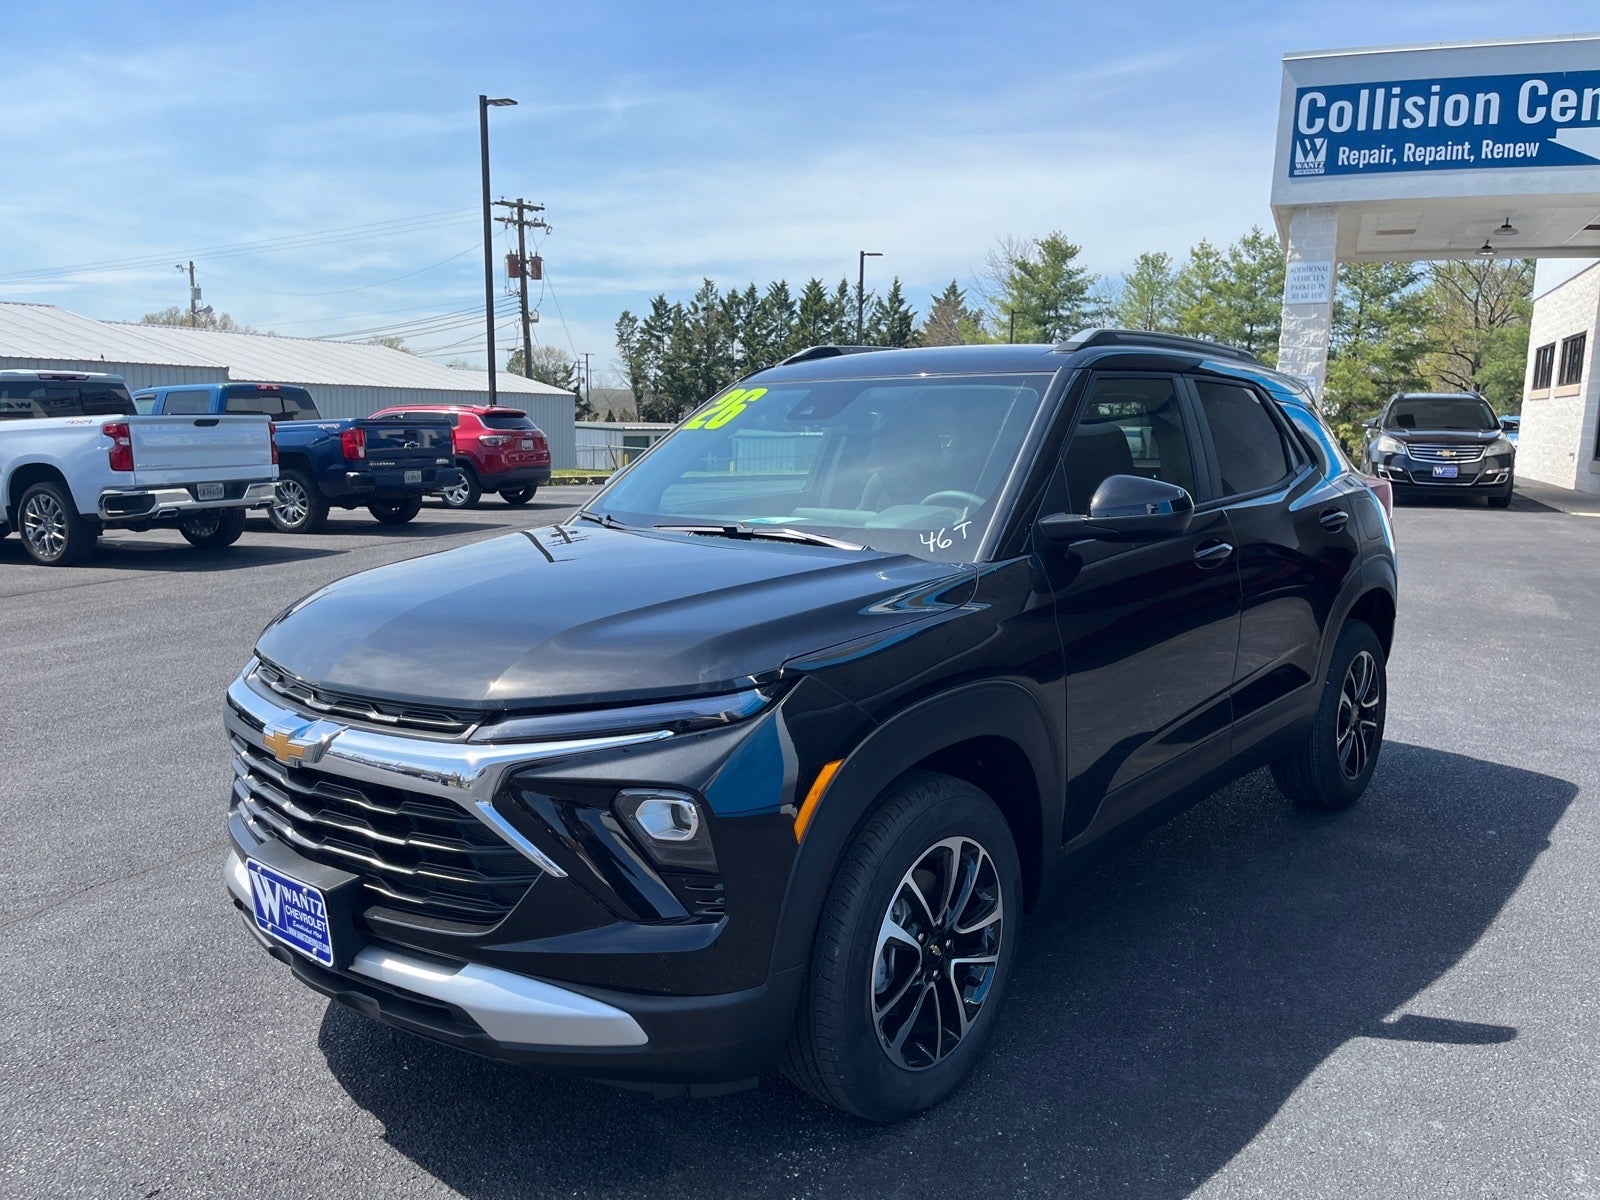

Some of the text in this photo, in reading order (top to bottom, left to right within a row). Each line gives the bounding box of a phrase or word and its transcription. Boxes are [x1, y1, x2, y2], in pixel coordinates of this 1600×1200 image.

[1298, 85, 1500, 135] Collision
[1295, 162, 1325, 170] WANTZ
[1338, 139, 1540, 168] Repair, Repaint, Renew
[1290, 264, 1329, 273] ADDITIONAL
[1292, 274, 1326, 282] VEHICLES
[681, 387, 769, 430] 26
[281, 885, 325, 918] WANTZ
[285, 904, 326, 932] CHEVROLET
